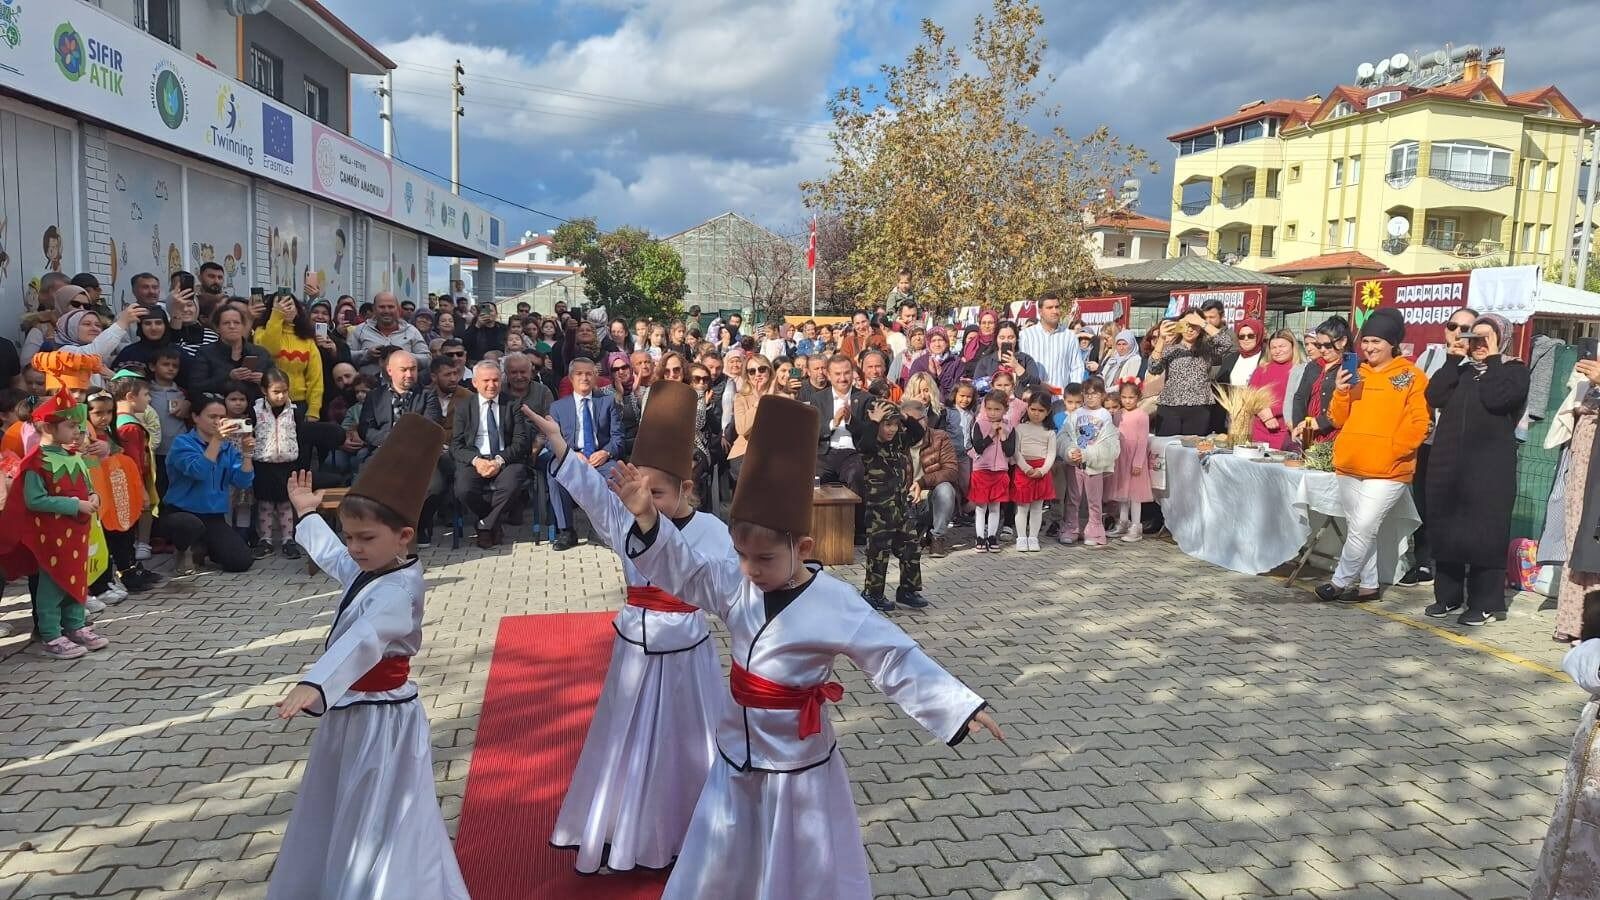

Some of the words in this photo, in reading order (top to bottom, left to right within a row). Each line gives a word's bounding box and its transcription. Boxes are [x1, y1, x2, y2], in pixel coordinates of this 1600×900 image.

[88, 38, 123, 72] SIFIR
[90, 63, 123, 96] ATIK
[205, 125, 254, 165] eTwinning
[264, 155, 294, 176] Erasmus+
[1398, 286, 1460, 298] MARMARA
